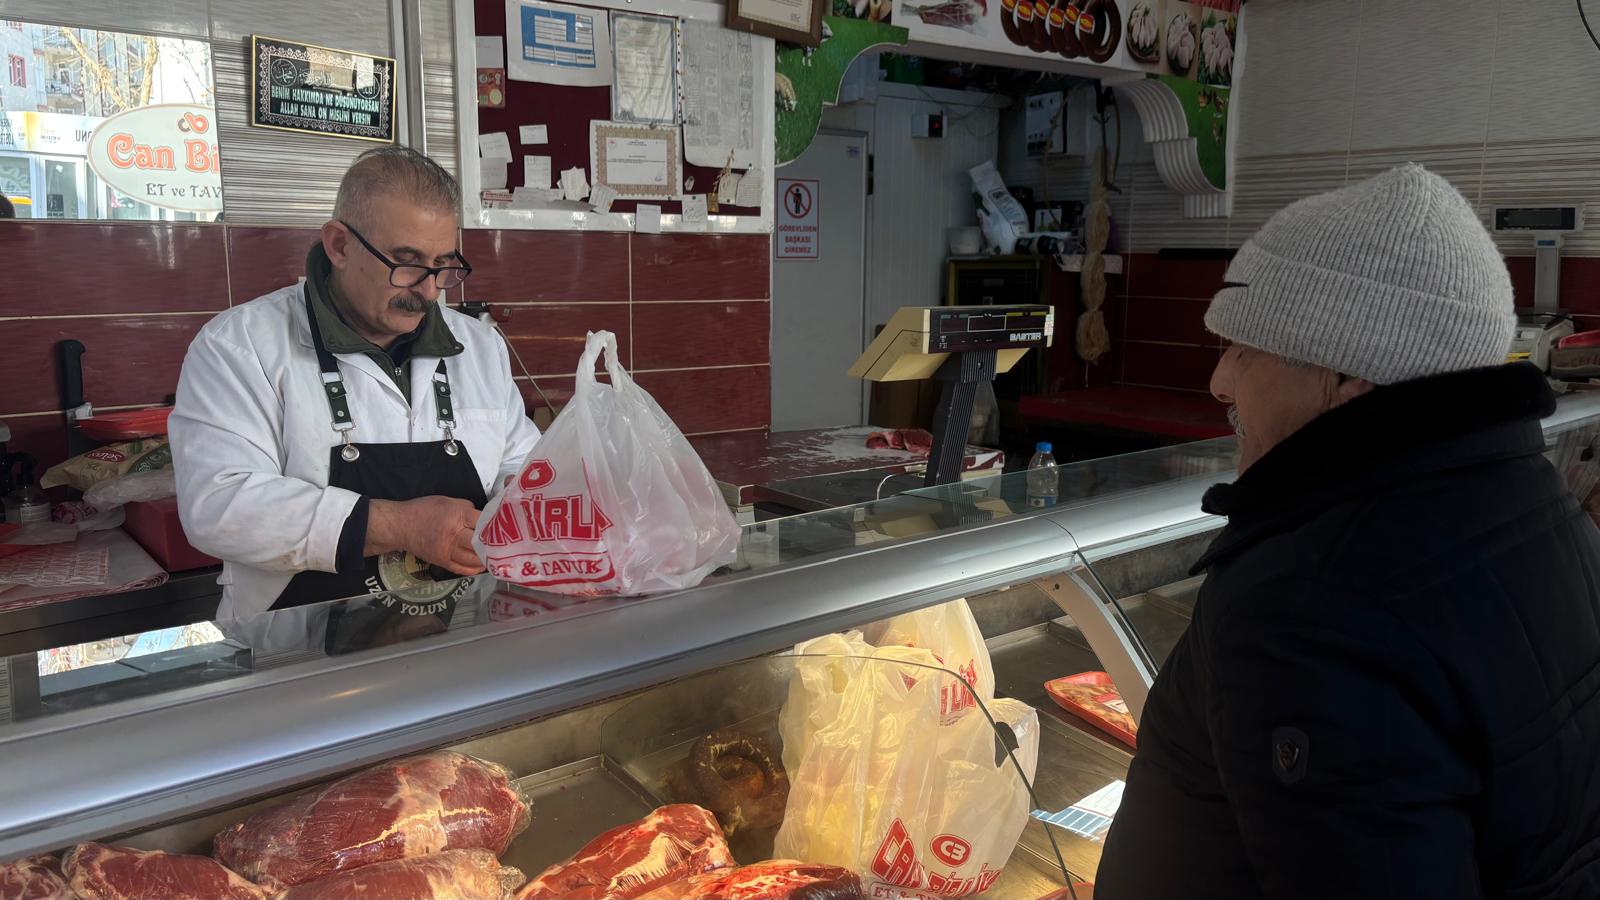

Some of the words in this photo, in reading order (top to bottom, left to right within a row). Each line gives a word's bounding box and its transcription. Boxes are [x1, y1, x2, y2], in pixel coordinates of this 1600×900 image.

[292, 88, 324, 105] HAKKIMDA
[325, 93, 334, 106] NE
[279, 101, 299, 116] ALLAH
[300, 104, 316, 118] SANA
[318, 107, 327, 120] ON
[106, 133, 176, 171] Can
[146, 183, 167, 196] ET
[171, 186, 185, 197] ve
[521, 561, 540, 577] &
[365, 575, 397, 608] UZUN
[400, 599, 448, 616] YOLUN
[873, 886, 894, 899] ET
